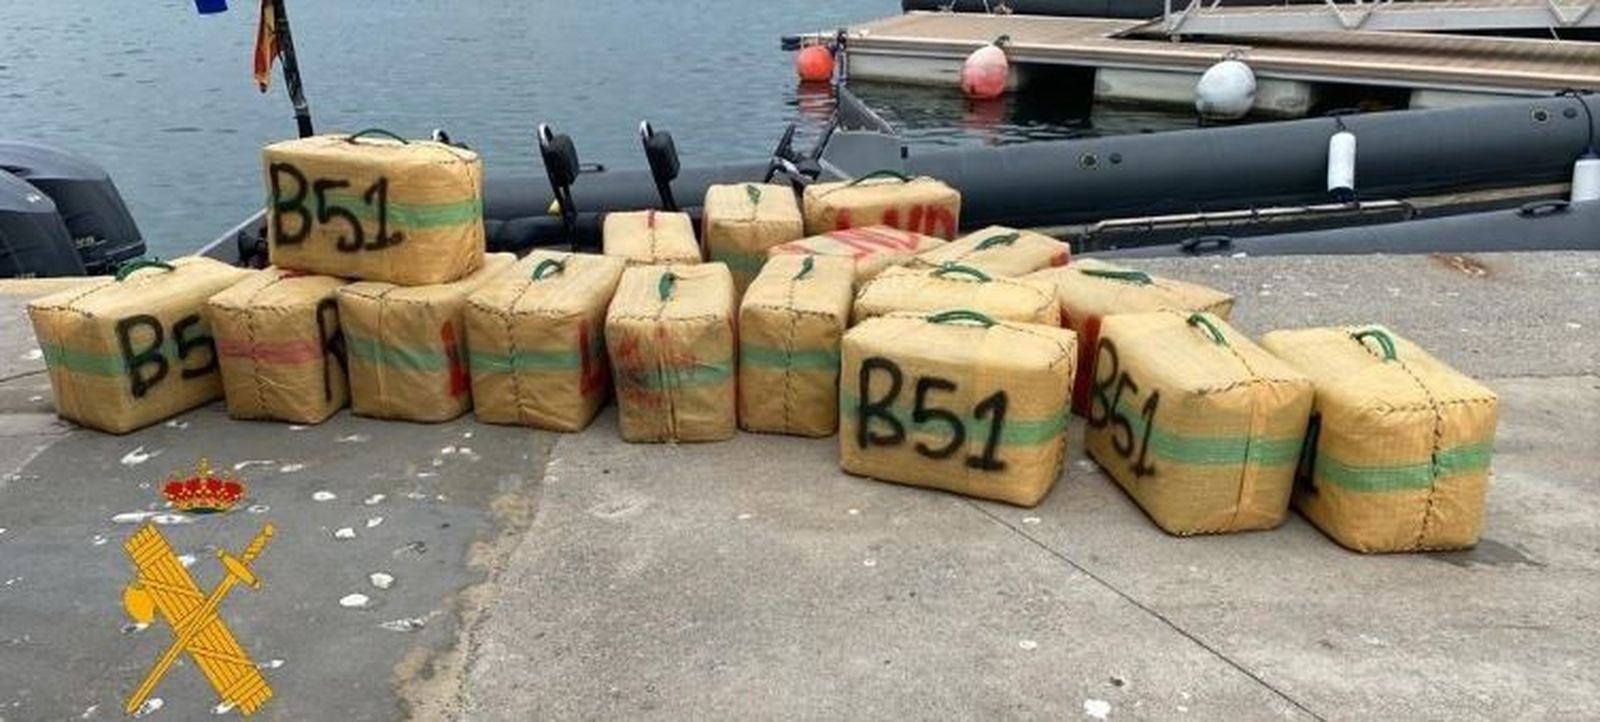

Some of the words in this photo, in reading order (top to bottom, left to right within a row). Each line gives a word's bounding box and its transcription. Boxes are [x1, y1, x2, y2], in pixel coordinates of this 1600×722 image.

[269, 162, 405, 252] B51
[858, 357, 1010, 471] B51
[1087, 336, 1160, 479] B51
